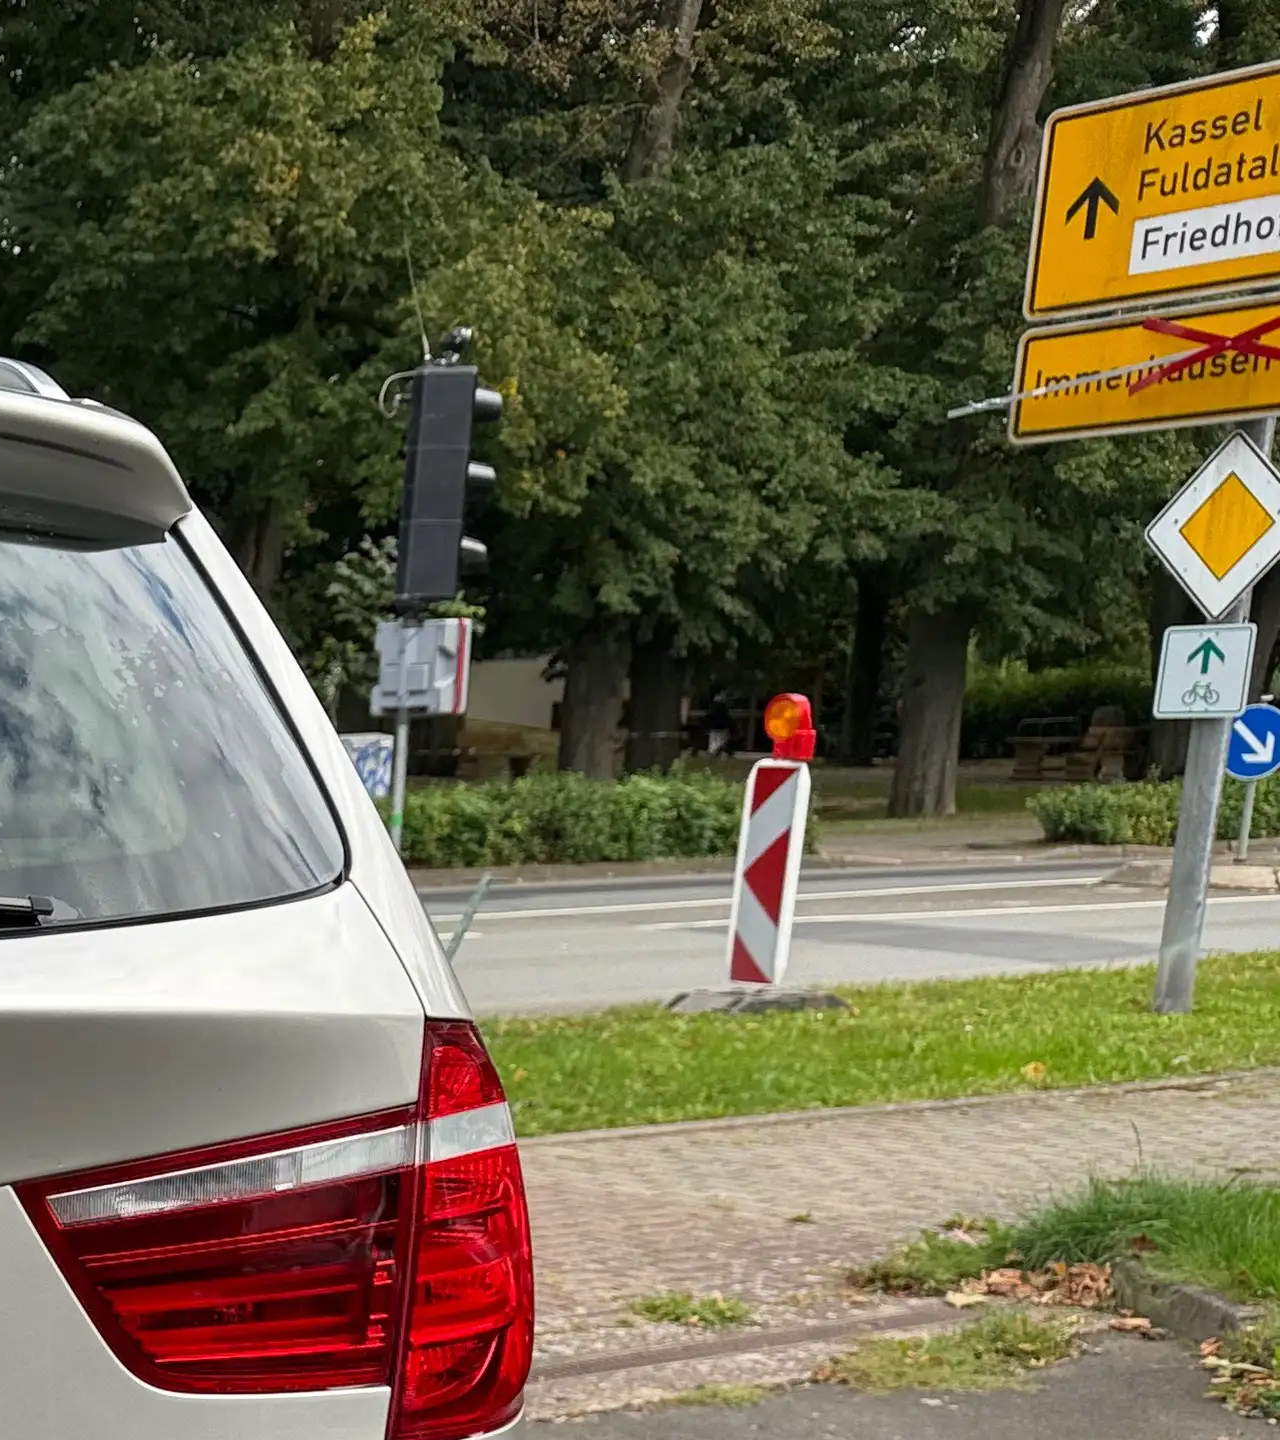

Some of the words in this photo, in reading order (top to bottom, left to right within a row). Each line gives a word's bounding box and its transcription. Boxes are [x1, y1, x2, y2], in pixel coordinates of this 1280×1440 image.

[1143, 98, 1263, 154] Kassel
[1137, 143, 1279, 203] Fuldatal
[1141, 212, 1280, 260] Friedho
